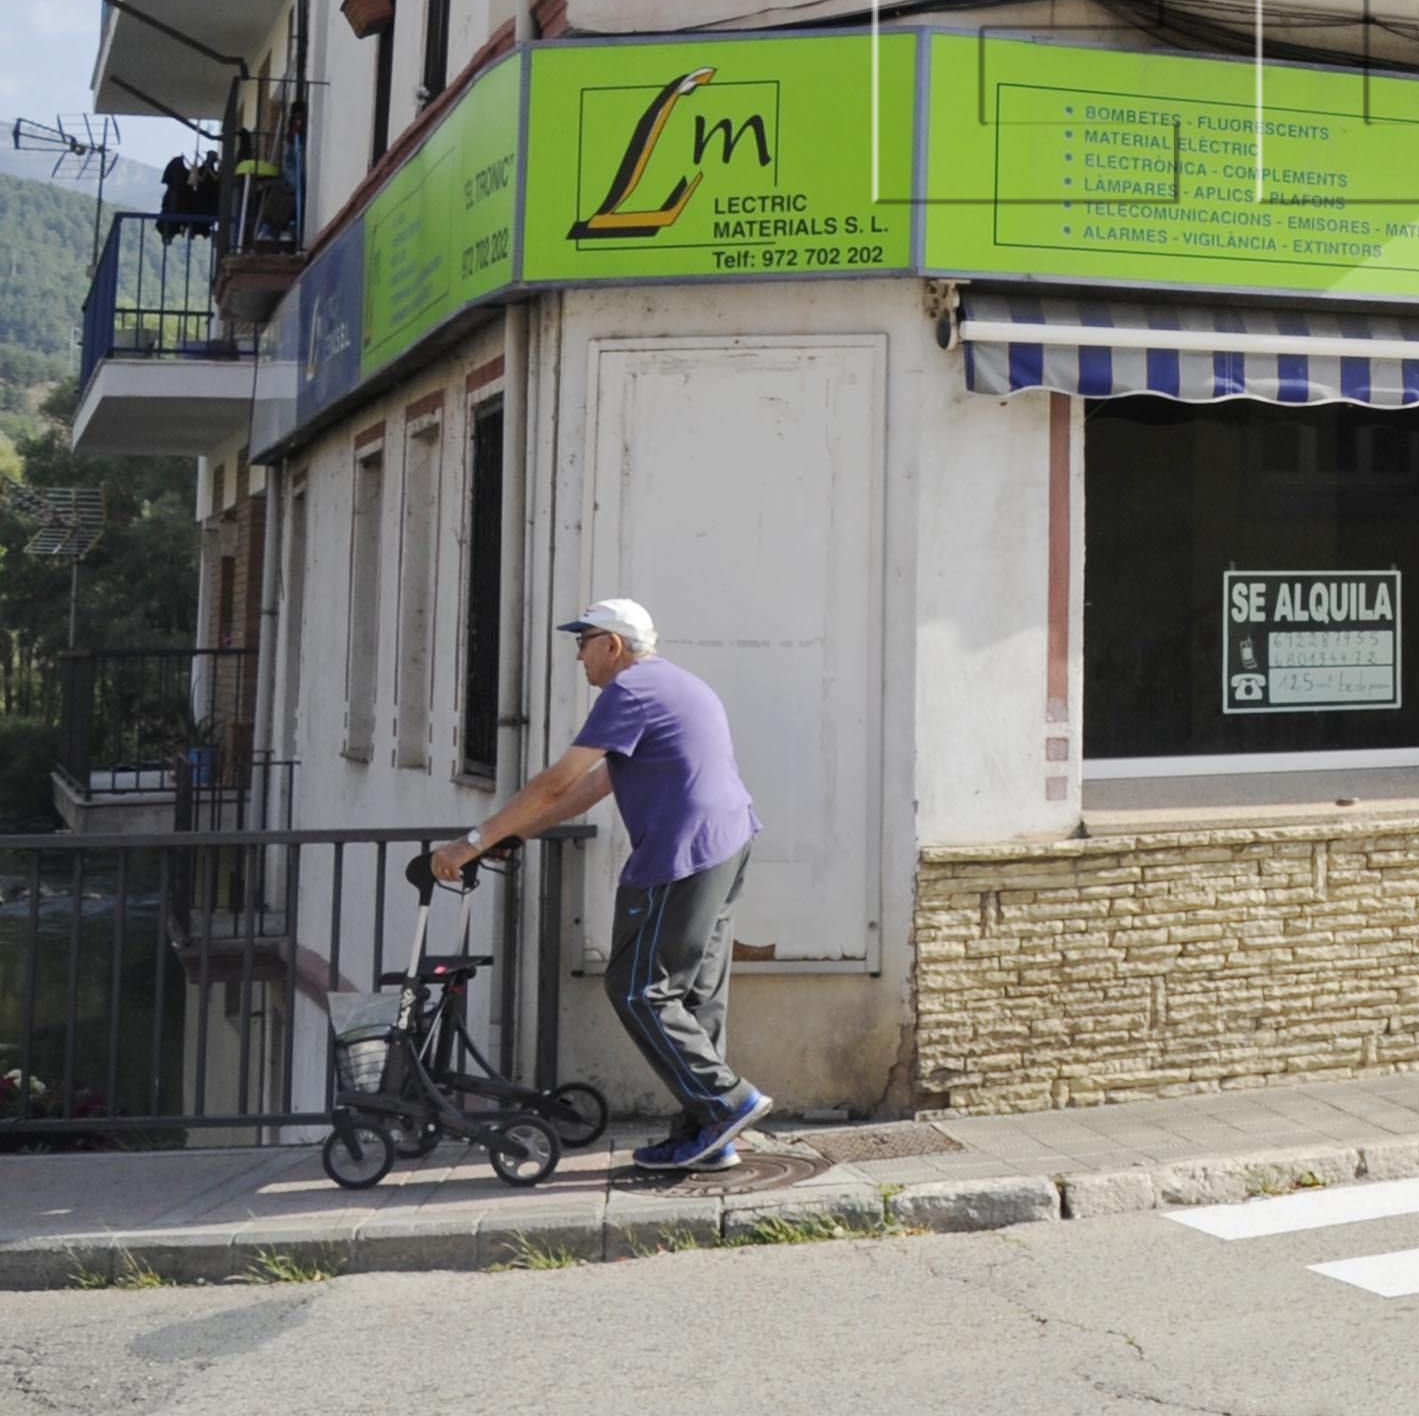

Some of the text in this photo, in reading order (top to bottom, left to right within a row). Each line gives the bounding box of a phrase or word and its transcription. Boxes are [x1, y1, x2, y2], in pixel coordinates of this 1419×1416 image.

[1085, 106, 1329, 140] BOMBETES FLUORESCENTS
[1084, 130, 1171, 150] MATERIAL
[1084, 153, 1348, 188] ELECTRÒNICA COMPLEMENTS
[713, 194, 808, 216] LECTRIC
[1194, 186, 1254, 203] APLICS
[1269, 191, 1346, 210] PLAFONS
[713, 217, 838, 240] MATERIALS
[1085, 201, 1272, 227] TELECOMUNICACIONS
[1287, 216, 1371, 235] EMISORES
[1083, 225, 1382, 259] ALARMES VIGILÀNCIA EXTINTORS
[712, 246, 883, 270] Telf: 972 702 202
[1231, 582, 1393, 624] SE ALQUILA
